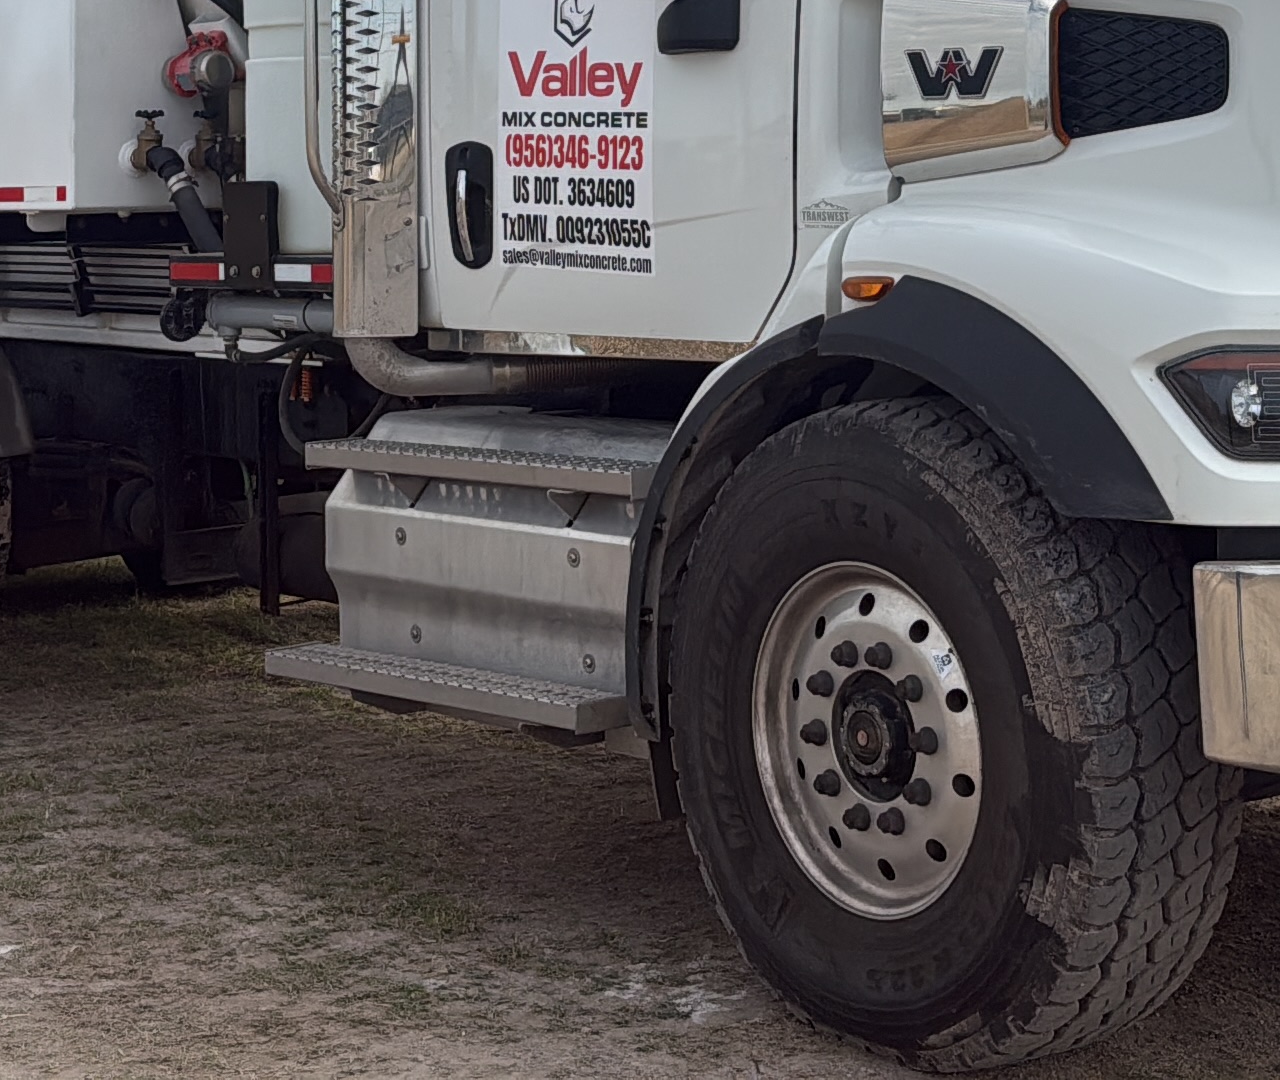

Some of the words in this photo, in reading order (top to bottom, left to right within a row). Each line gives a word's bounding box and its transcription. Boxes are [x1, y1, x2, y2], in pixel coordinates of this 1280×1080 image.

[508, 46, 643, 107] Valley
[501, 111, 536, 128] MIX
[540, 111, 648, 128] CONCRETE
[505, 134, 644, 170] (956)346-9123
[513, 175, 529, 204] US
[534, 176, 563, 205] DOT.
[567, 178, 635, 208] 3634609
[501, 213, 552, 243] TxDMV.
[556, 216, 651, 248] 009231055C
[801, 210, 849, 222] TRANSWEST
[502, 248, 652, 273] sales@valleymixconcrete.com
